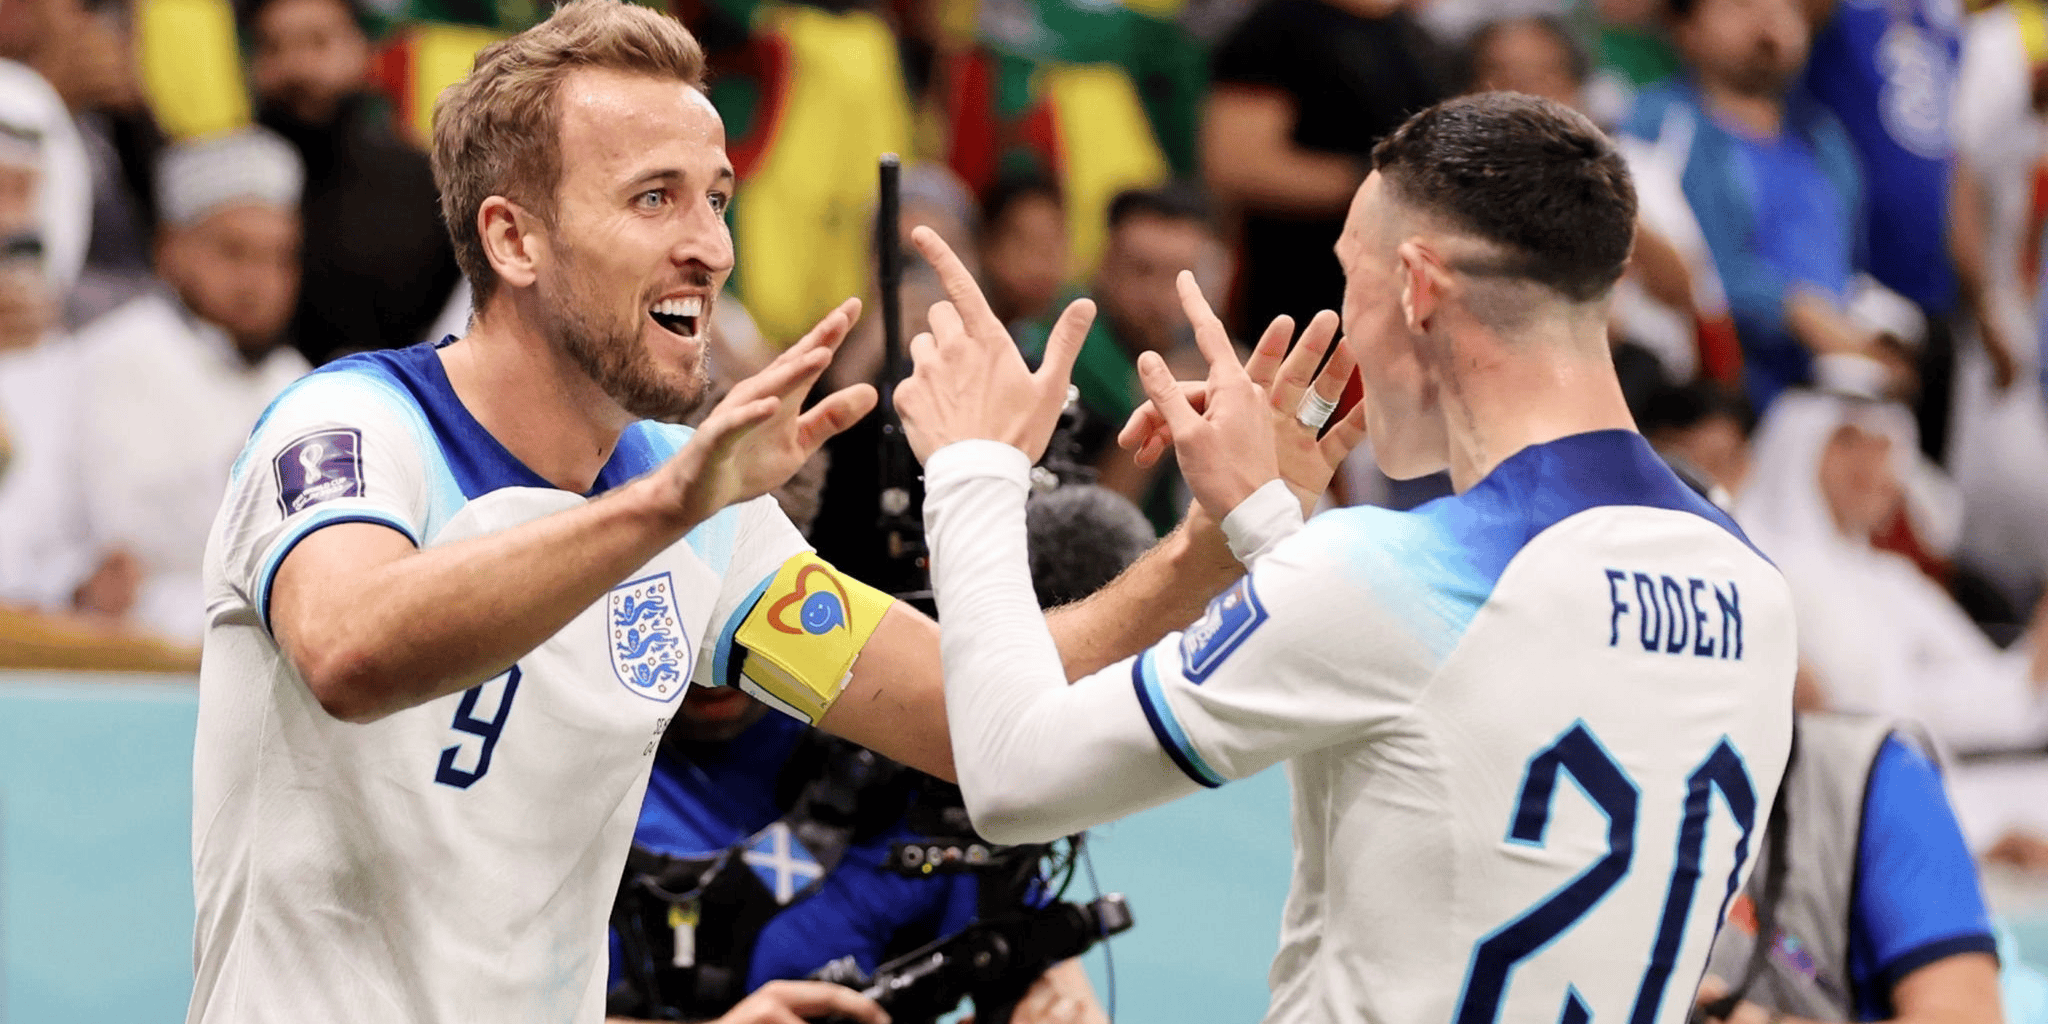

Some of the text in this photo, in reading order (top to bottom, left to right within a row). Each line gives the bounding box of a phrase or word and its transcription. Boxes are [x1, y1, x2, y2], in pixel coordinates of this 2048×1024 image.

[1604, 568, 1743, 661] FODEN
[434, 664, 522, 789] 9
[1451, 717, 1758, 1024] 20
